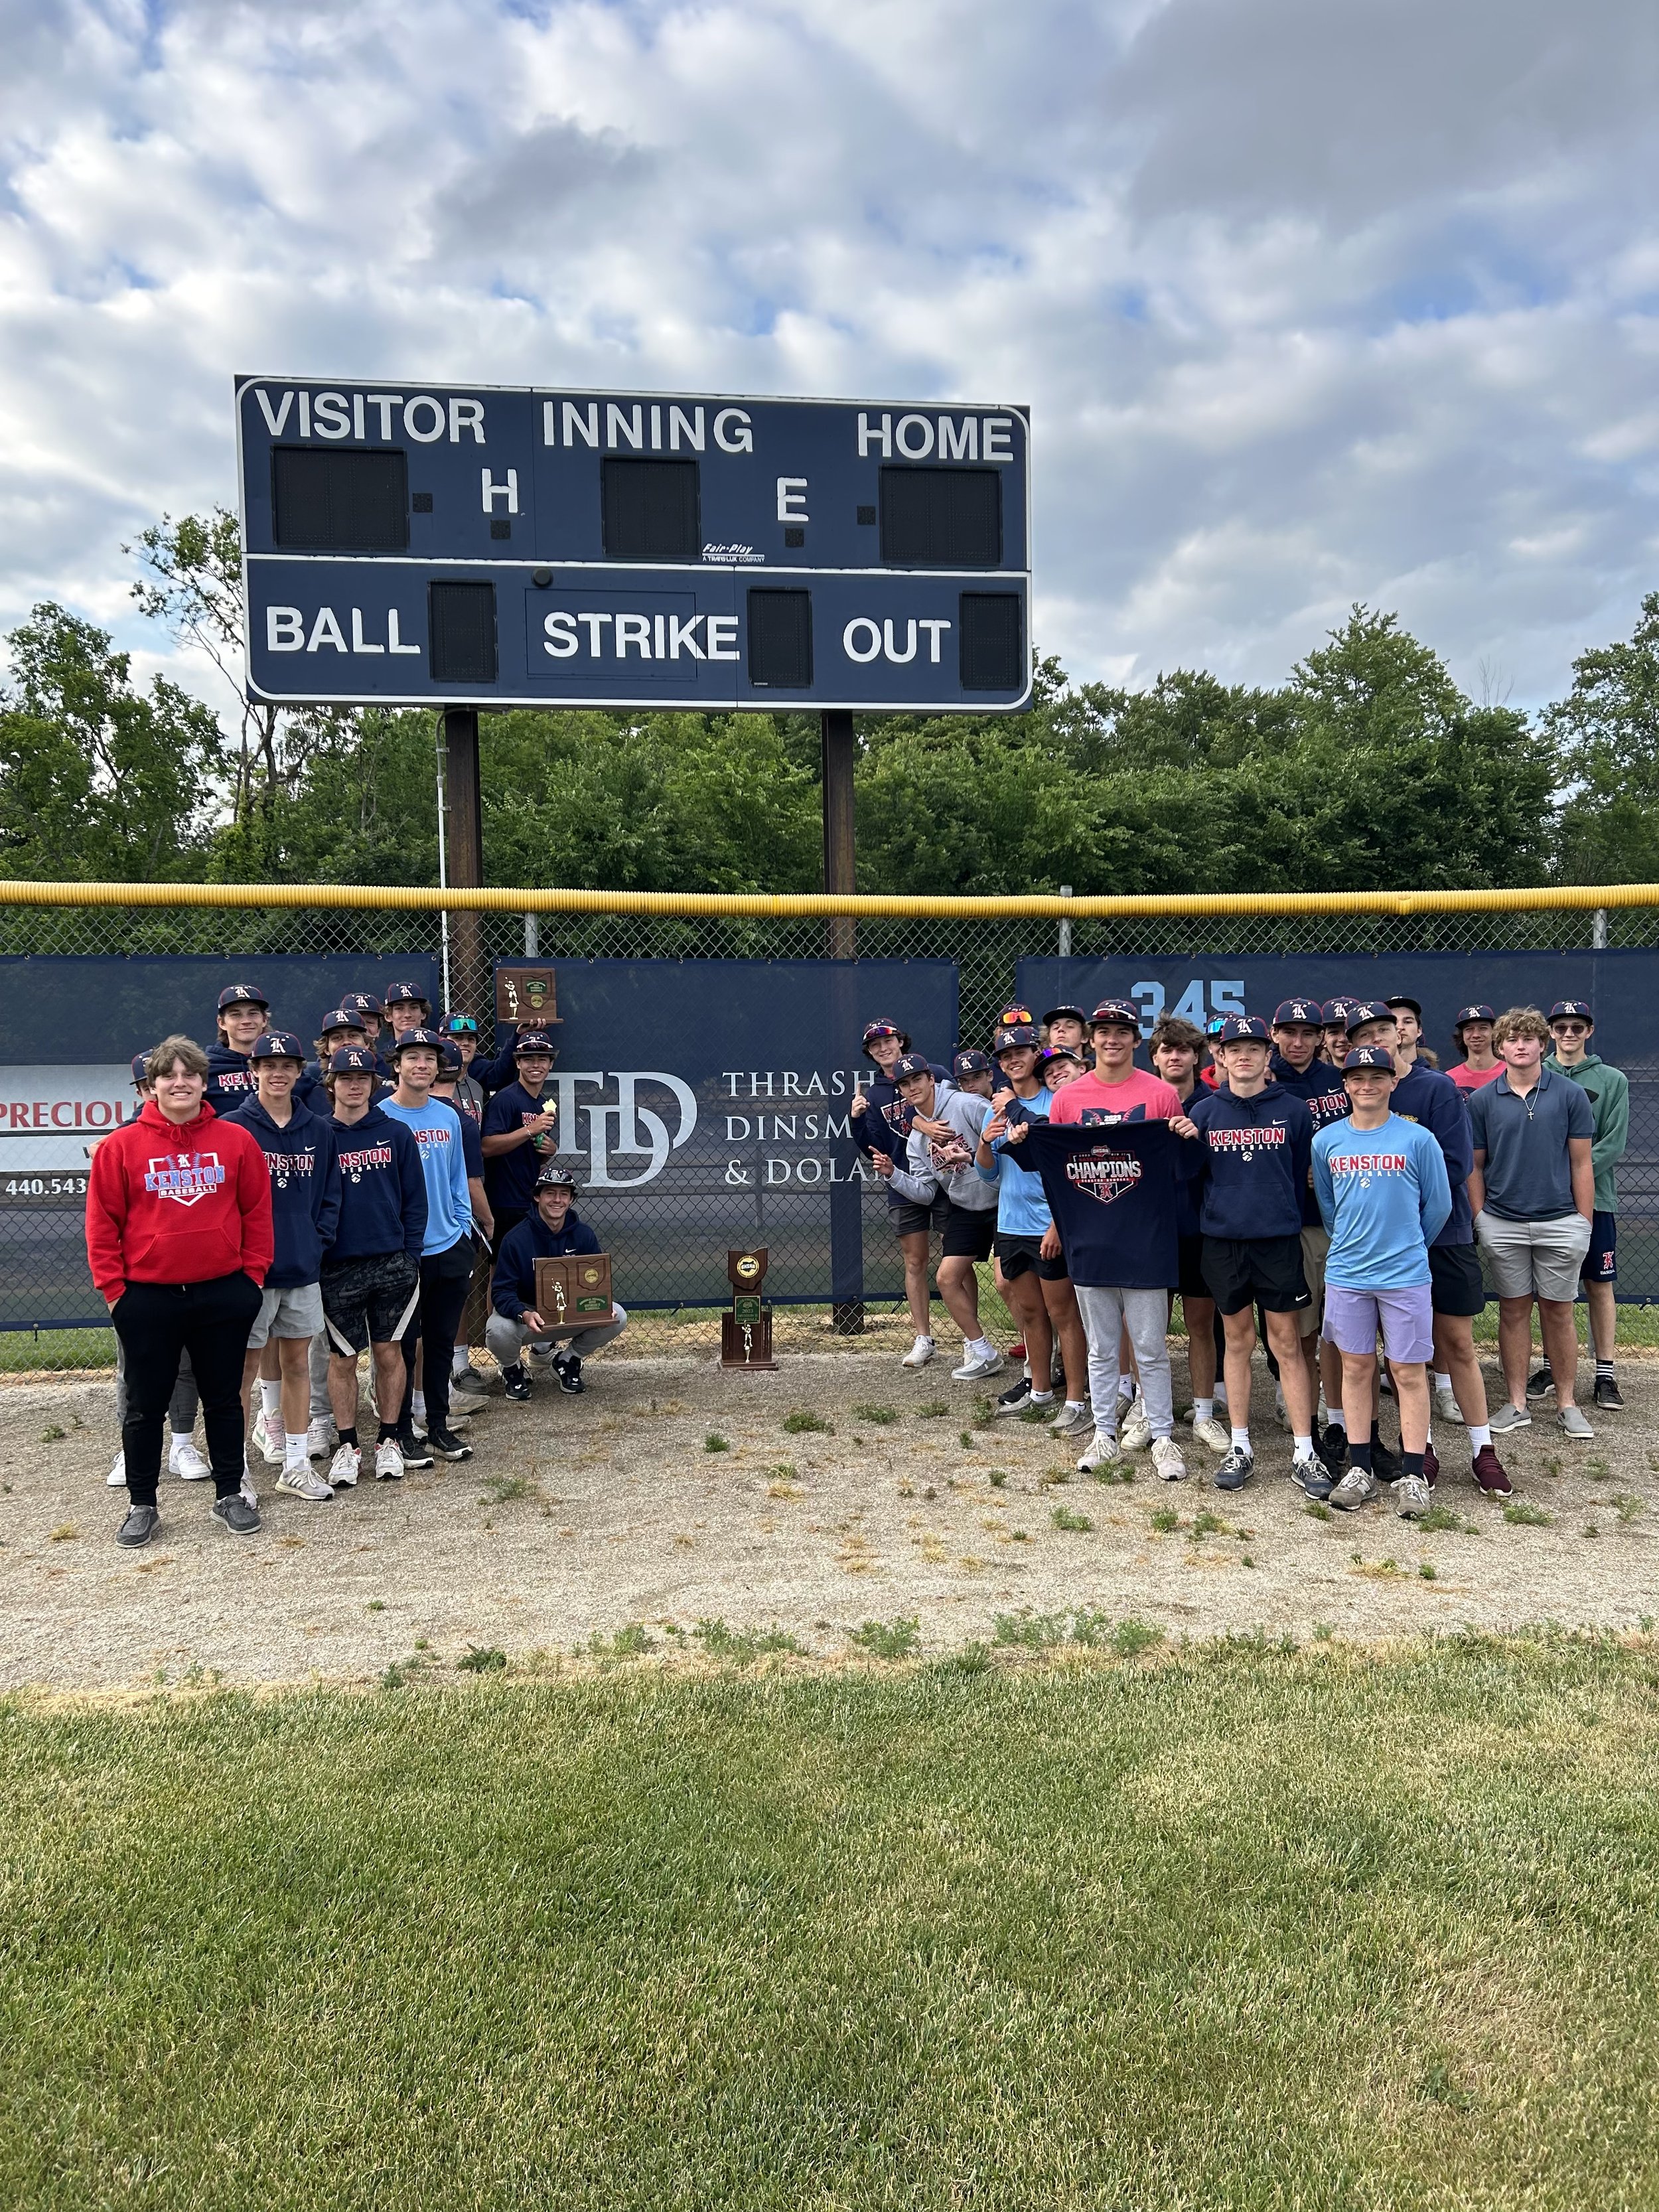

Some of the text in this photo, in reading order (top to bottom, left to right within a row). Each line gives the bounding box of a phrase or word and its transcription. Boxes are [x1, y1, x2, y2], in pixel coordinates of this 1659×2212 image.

[255, 389, 1014, 461] VISITOR INNING HOME
[481, 467, 518, 514] H
[776, 477, 809, 522] E
[266, 605, 952, 664] BALL STRIKE OUT
[1131, 980, 1246, 1039] 345
[722, 1070, 877, 1097] THRASH
[724, 1114, 854, 1142] DINSM
[1208, 1128, 1286, 1147] KENSTON
[725, 1159, 752, 1185] &
[1066, 1160, 1142, 1179] CHAMPIONS
[1329, 1153, 1407, 1173] KENSTON
[144, 1165, 226, 1192] KENSTON
[160, 1185, 214, 1197] BASEBALL
